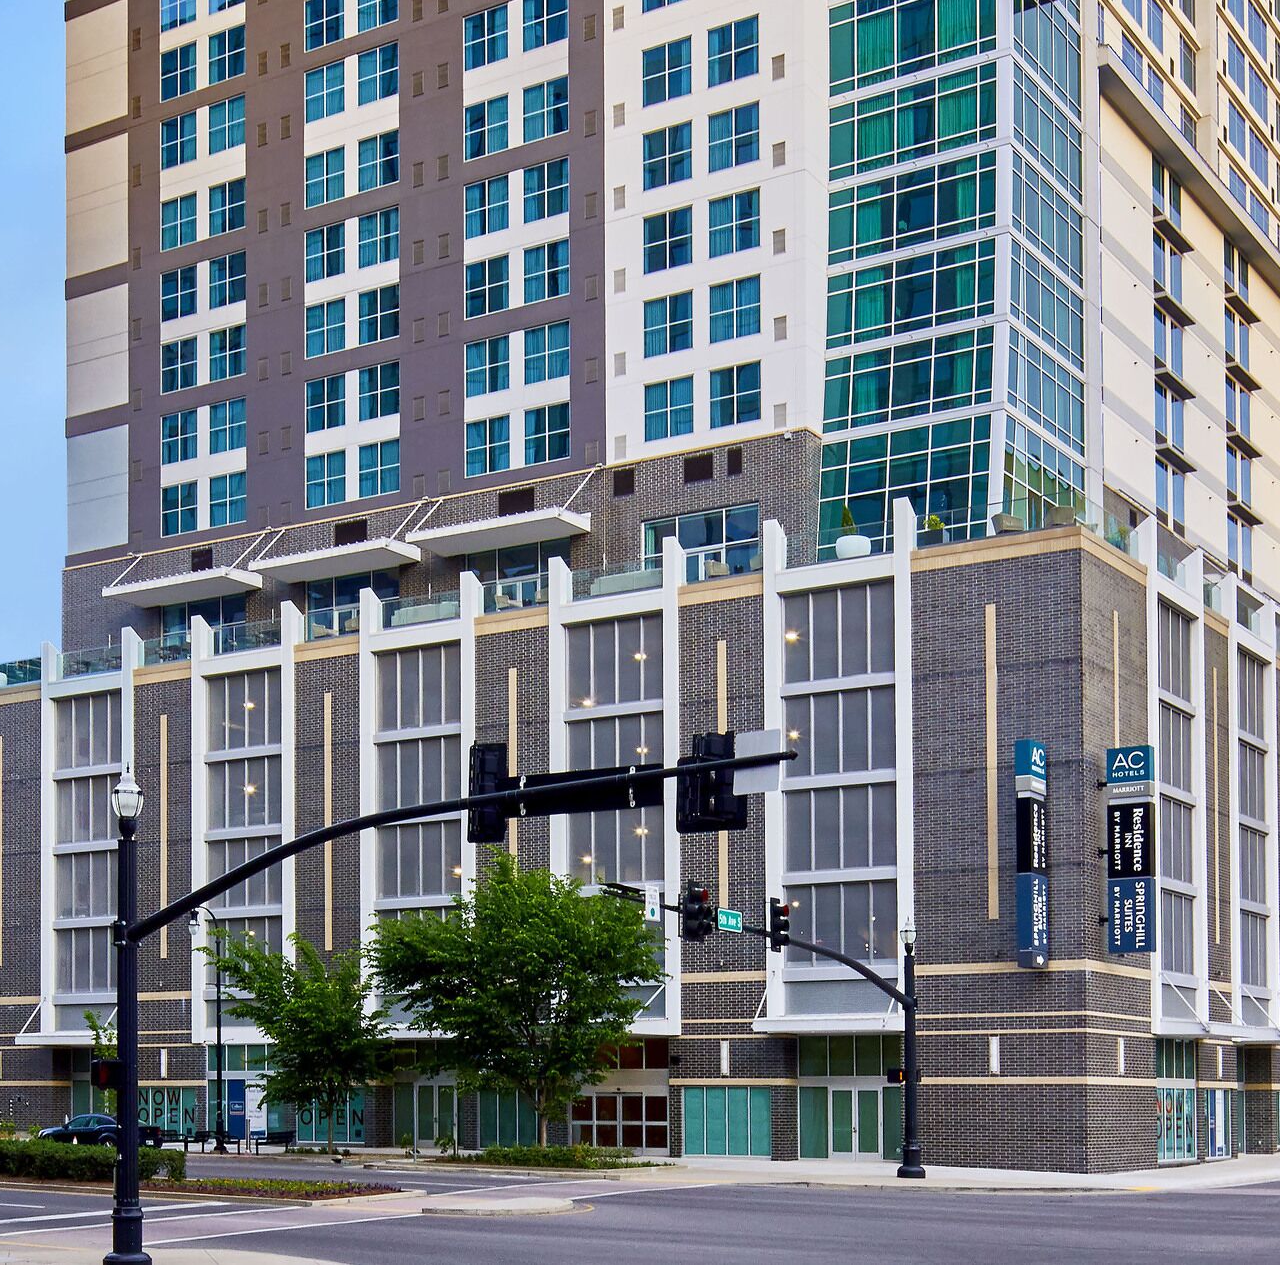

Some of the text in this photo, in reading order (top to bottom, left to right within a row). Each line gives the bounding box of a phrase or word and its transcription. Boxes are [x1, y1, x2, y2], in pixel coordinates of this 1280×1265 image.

[1031, 746, 1045, 767] AC
[1112, 750, 1145, 770] AC
[1112, 769, 1145, 778] HOTELS
[1112, 785, 1145, 794] MARRIOTT
[1114, 811, 1121, 823] BY
[1124, 832, 1133, 848] INN
[1133, 807, 1144, 872] Residence
[1113, 887, 1121, 898] BY
[1124, 898, 1133, 933] SUITES
[1135, 881, 1146, 949] SPRINGHILL
[138, 1089, 180, 1105] NOW
[138, 1107, 195, 1124] OPEN
[300, 1108, 364, 1126] OPEN
